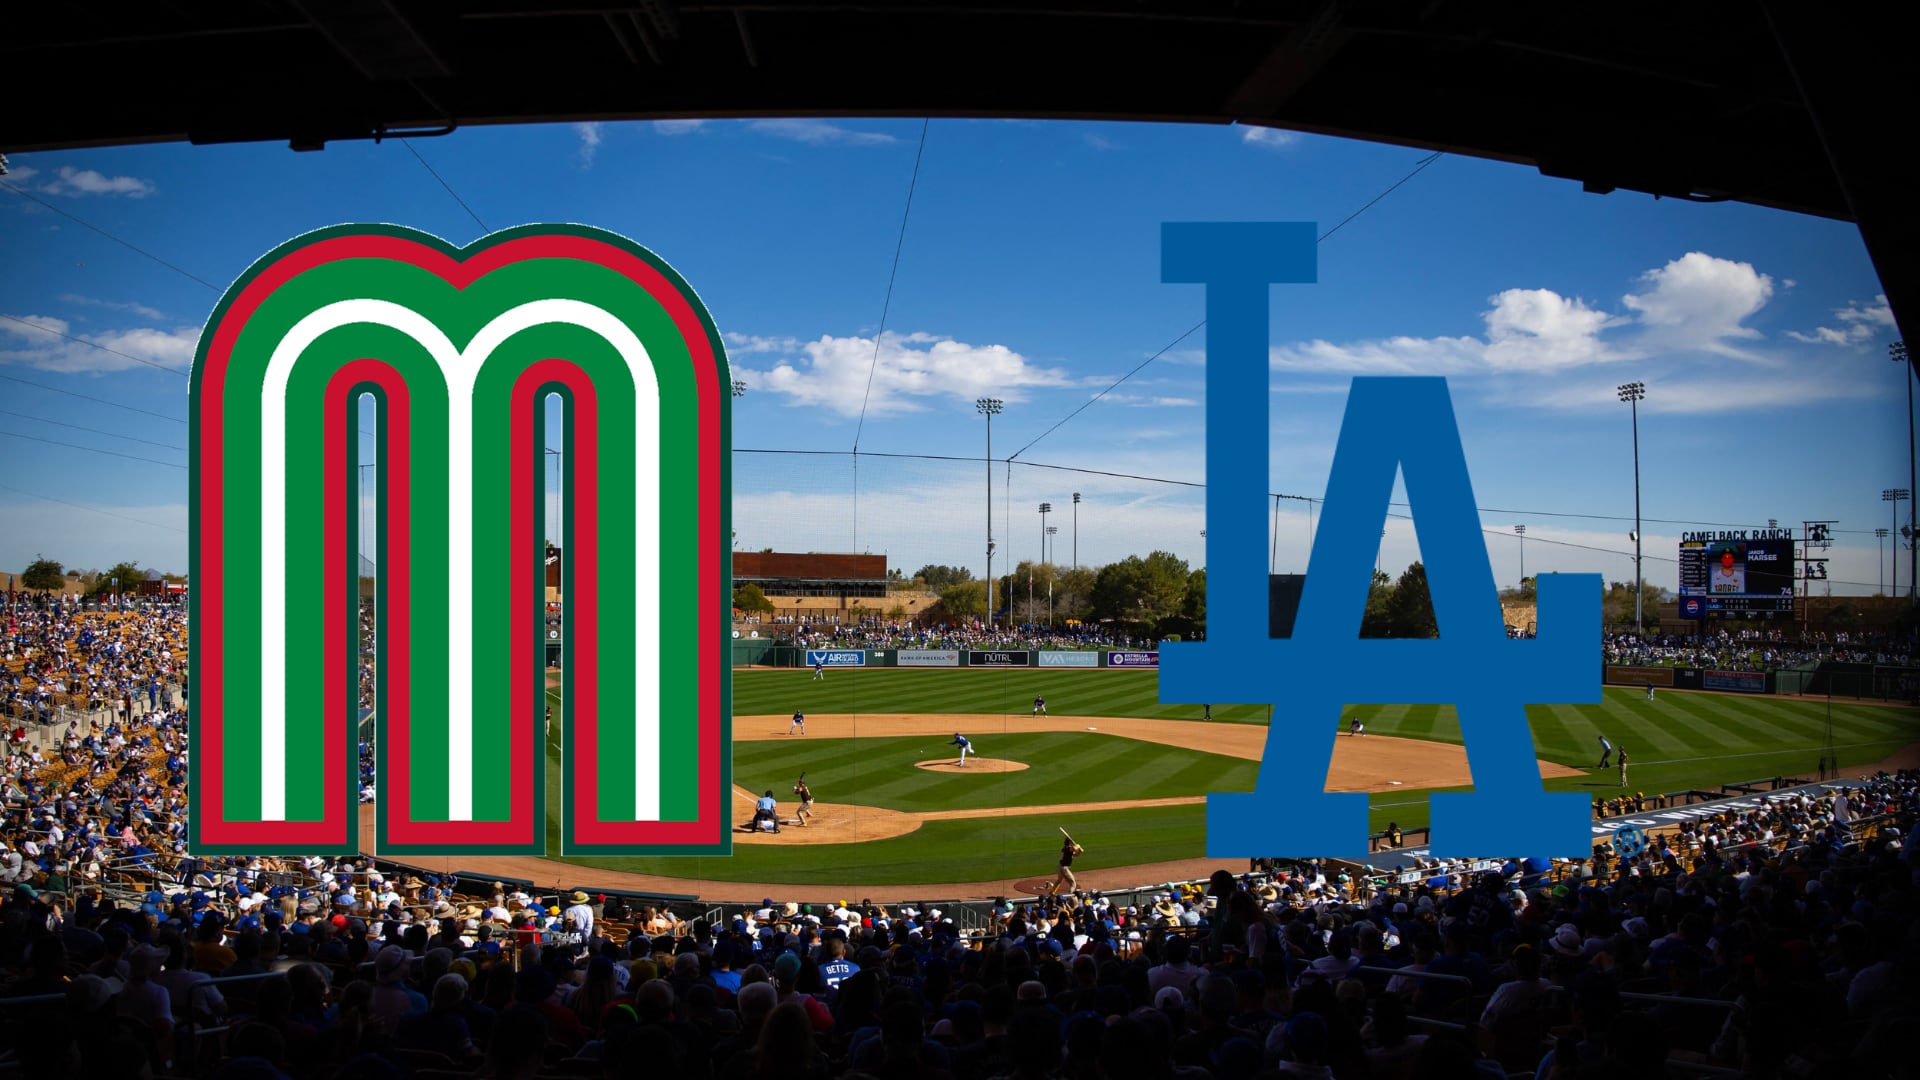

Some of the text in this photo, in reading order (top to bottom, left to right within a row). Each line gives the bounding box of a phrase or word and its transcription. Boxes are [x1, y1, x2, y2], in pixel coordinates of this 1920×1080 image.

[1682, 528, 1792, 541] CAMELBACK RANCH
[1780, 587, 1792, 595] 74
[825, 964, 849, 974] BETTS
